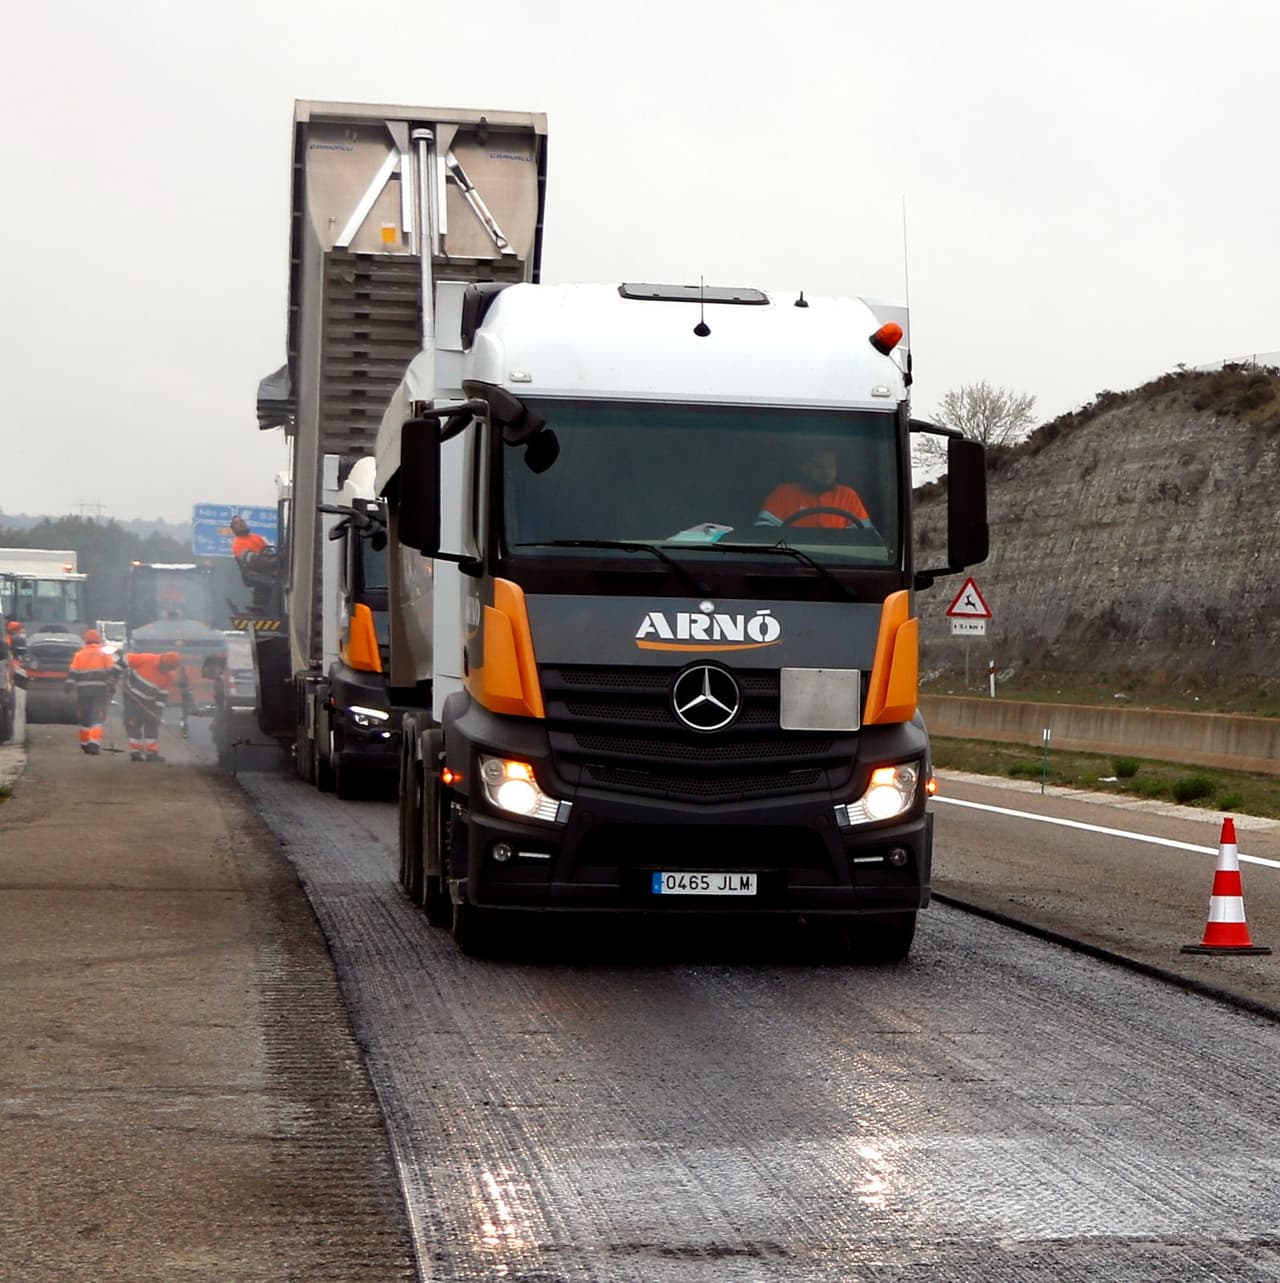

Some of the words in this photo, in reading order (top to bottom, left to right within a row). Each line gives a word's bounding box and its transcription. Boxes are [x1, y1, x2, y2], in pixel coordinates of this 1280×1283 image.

[635, 609, 781, 643] ARNÓ
[666, 875, 710, 890] 0465
[717, 875, 750, 891] JLM
